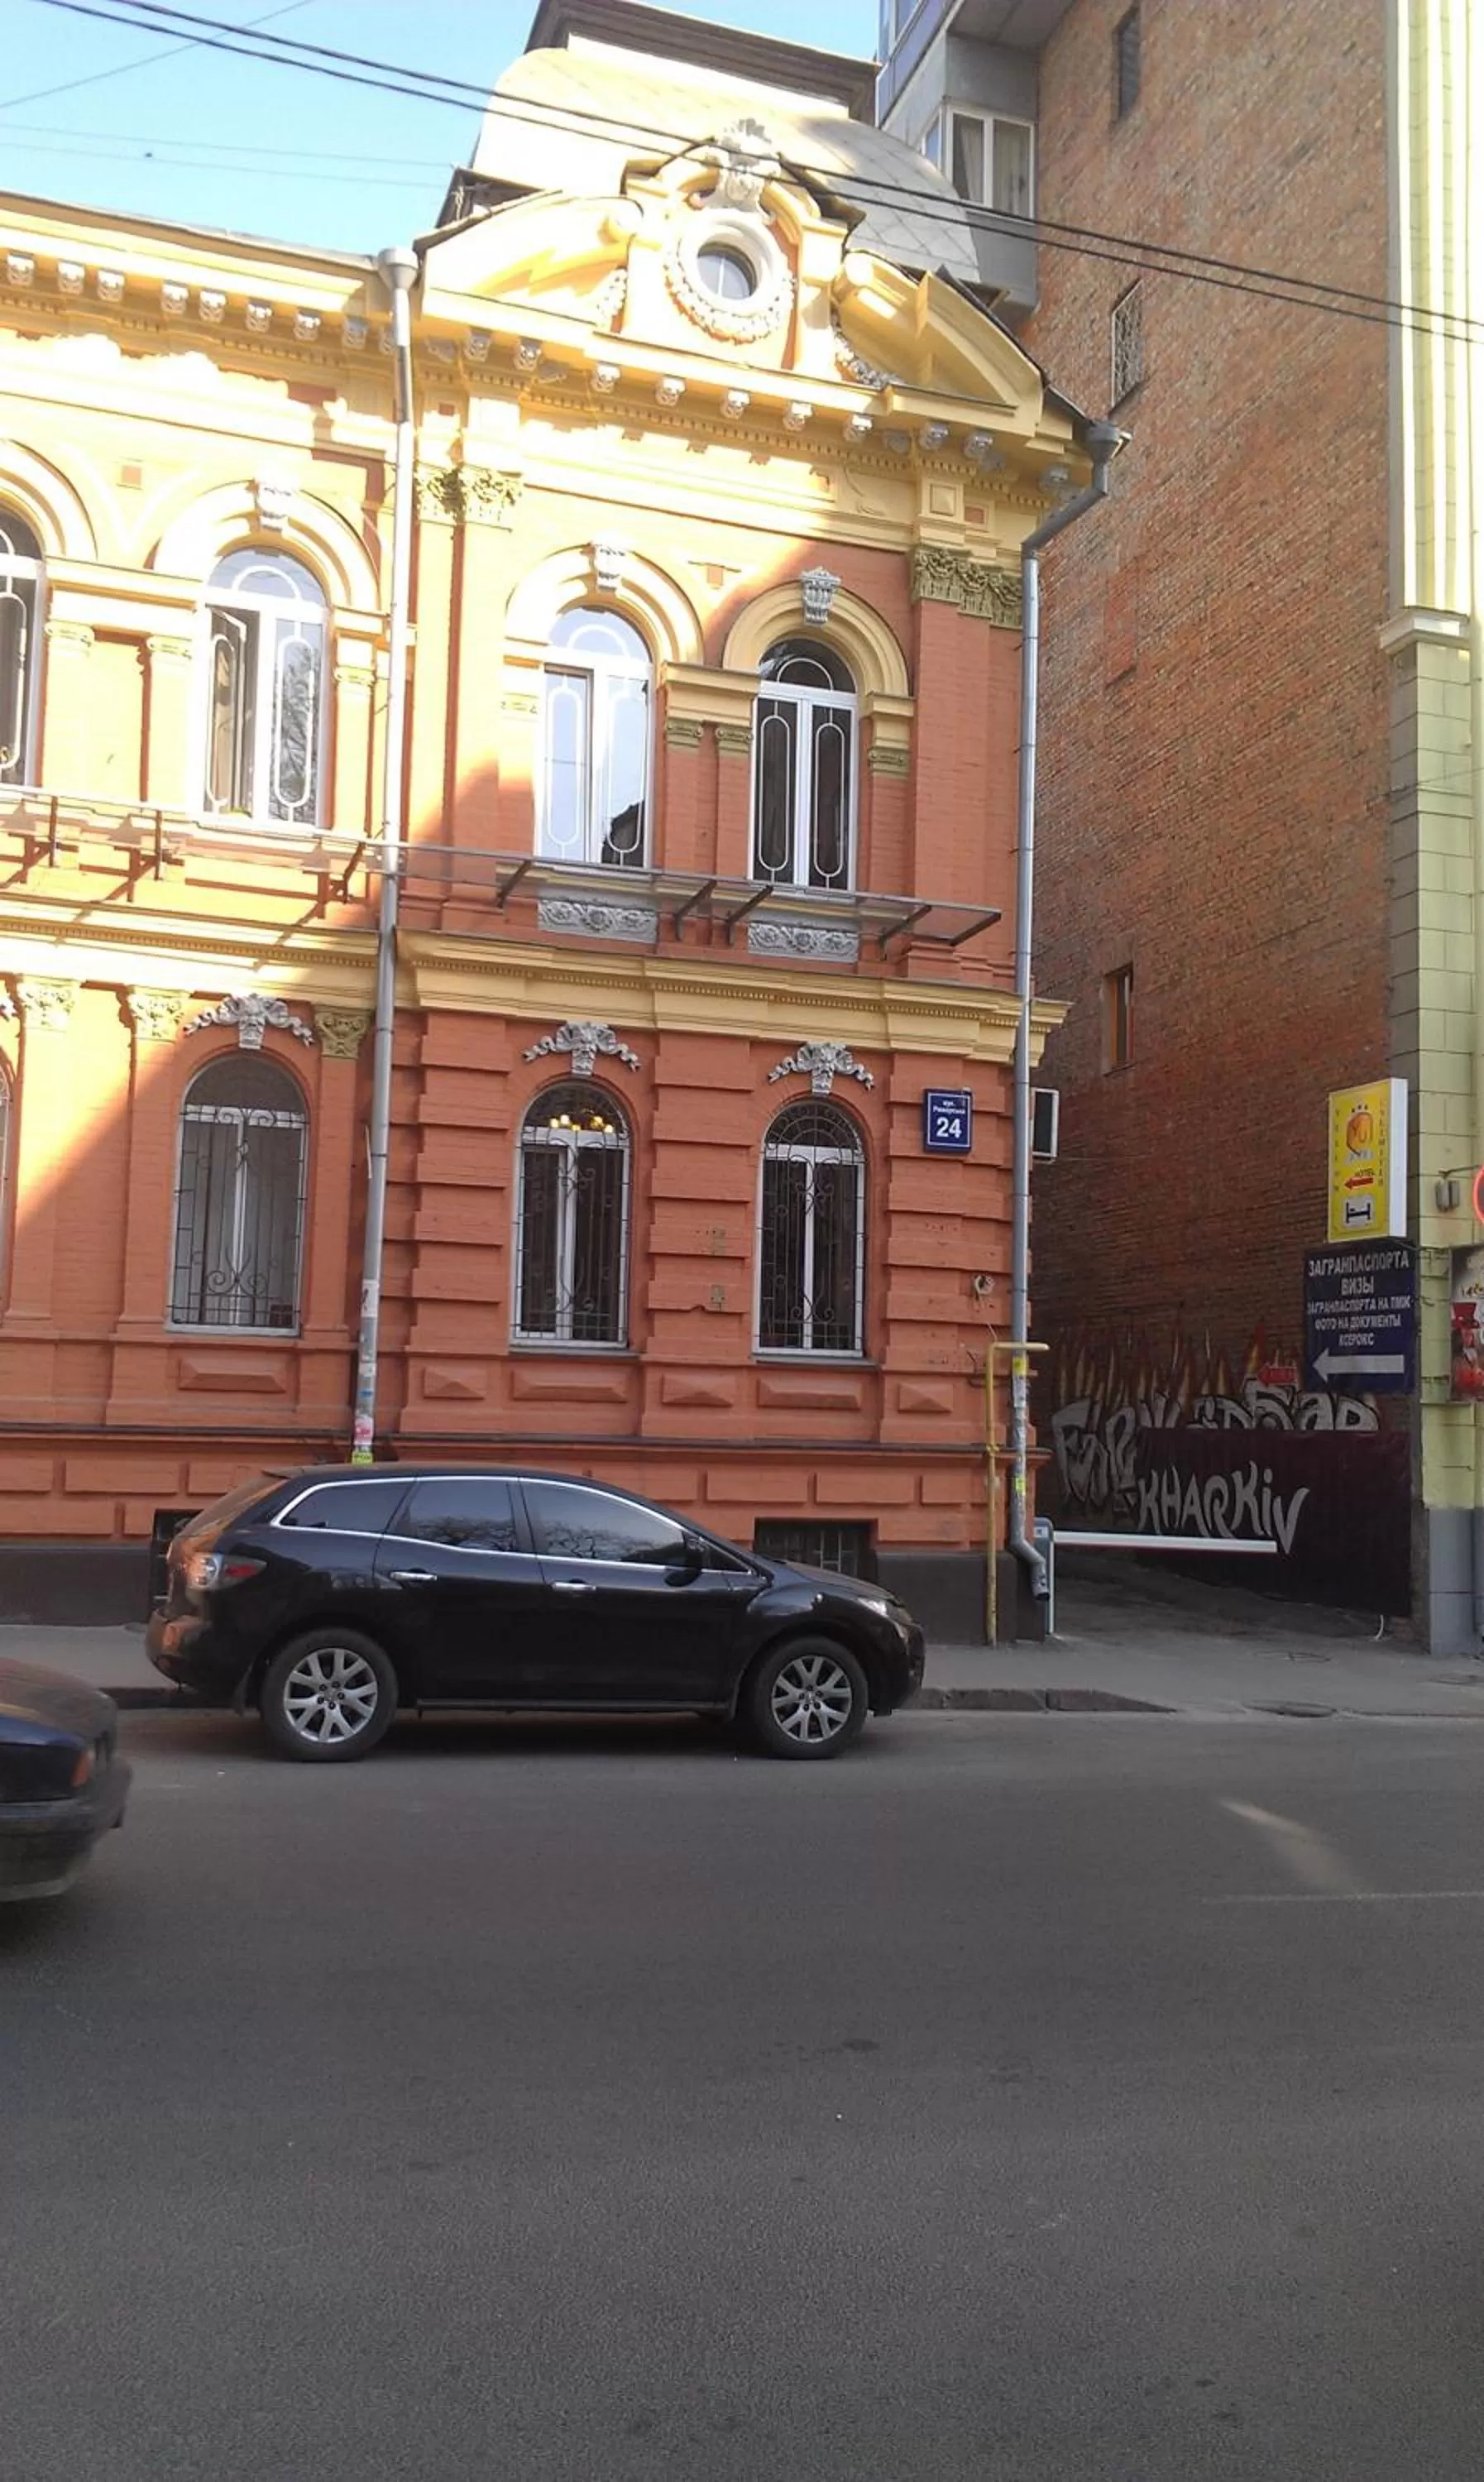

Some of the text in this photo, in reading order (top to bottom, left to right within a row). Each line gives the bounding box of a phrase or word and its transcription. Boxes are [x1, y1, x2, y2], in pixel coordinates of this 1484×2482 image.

[936, 1116, 962, 1138] 24
[1308, 1250, 1410, 1277] ЗАГРАНПАСПОРТА
[1341, 1275, 1375, 1296] ВИЗЫ
[1377, 1296, 1389, 1310] НА
[1338, 1316, 1348, 1330] НА
[1338, 1332, 1375, 1346] КСЕРОКС
